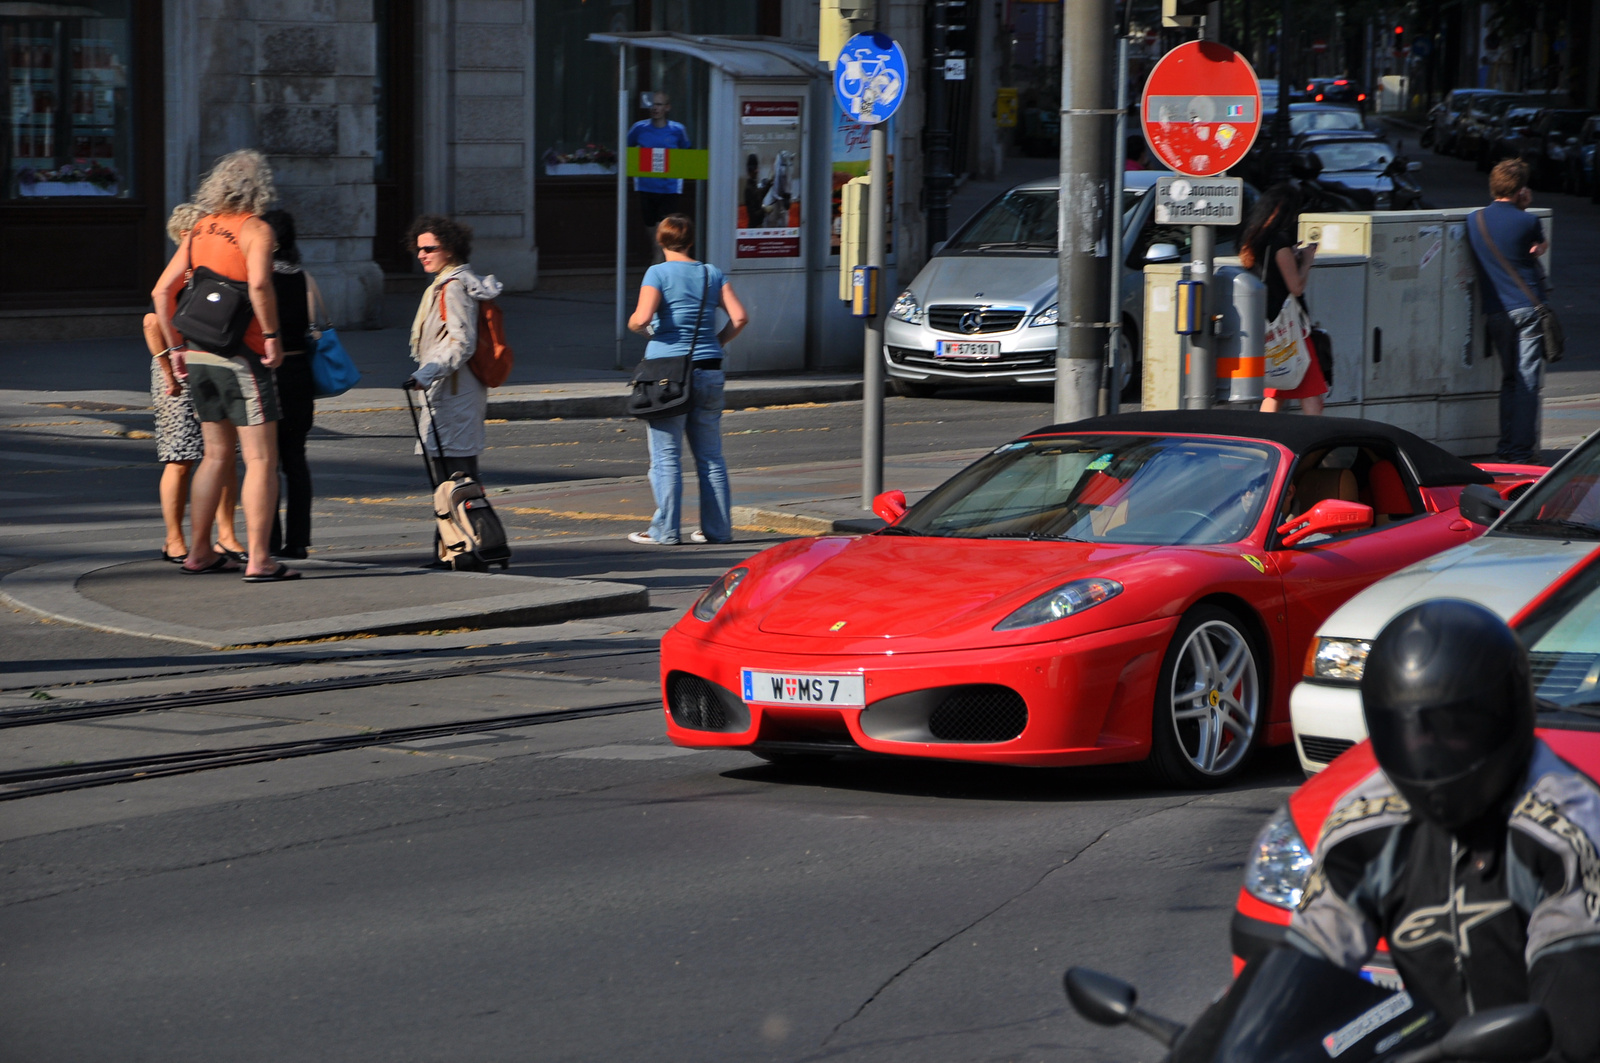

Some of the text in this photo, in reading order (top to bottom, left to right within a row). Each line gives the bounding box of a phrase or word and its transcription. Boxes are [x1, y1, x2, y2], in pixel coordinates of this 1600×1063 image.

[771, 676, 840, 702] W MS 7
